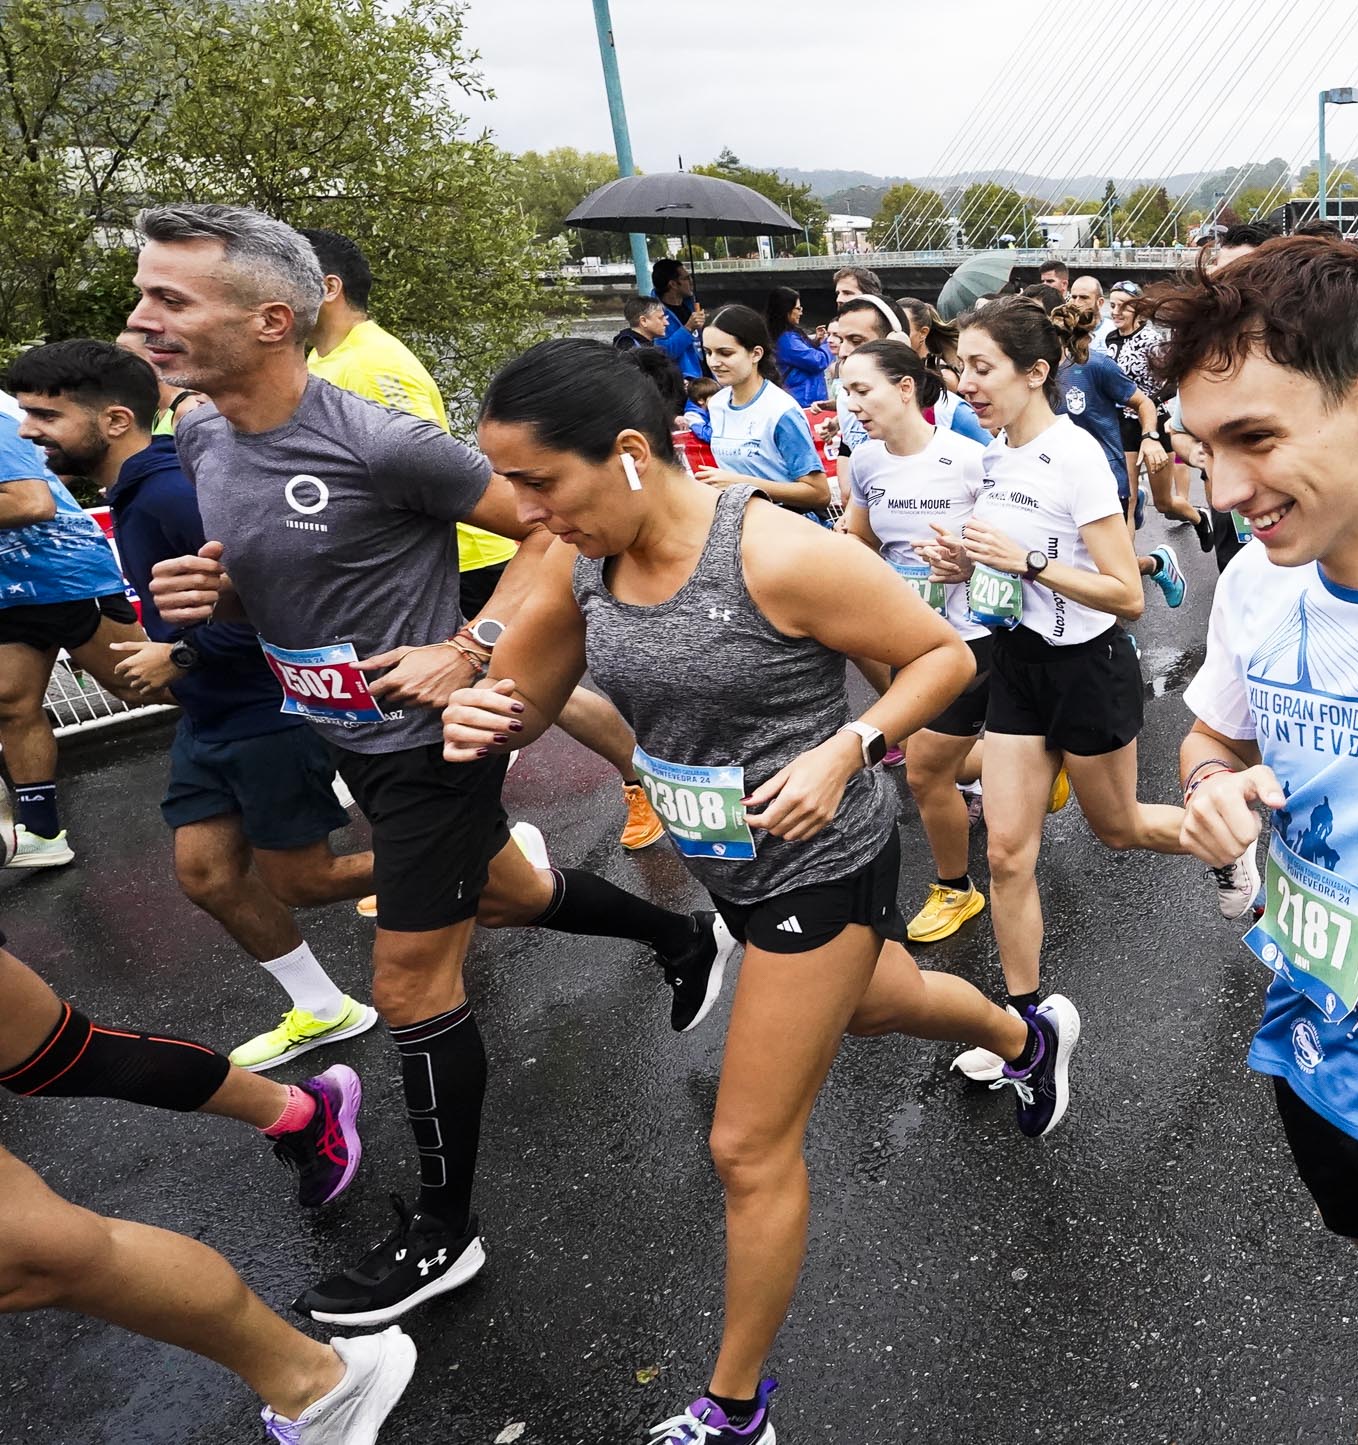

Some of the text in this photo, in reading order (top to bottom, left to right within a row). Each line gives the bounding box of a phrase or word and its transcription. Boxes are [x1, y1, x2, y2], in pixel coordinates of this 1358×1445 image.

[887, 498, 951, 510] MANUEL MOURE
[1010, 491, 1040, 509] MOURE
[1249, 687, 1269, 712] XLII
[1272, 693, 1314, 722] GRAN
[700, 776, 711, 784] 24
[643, 774, 728, 831] 2308
[1286, 863, 1351, 906] PONTEVEDRA 24
[1320, 874, 1352, 896] CAIXABANK
[1277, 876, 1352, 971] 2187
